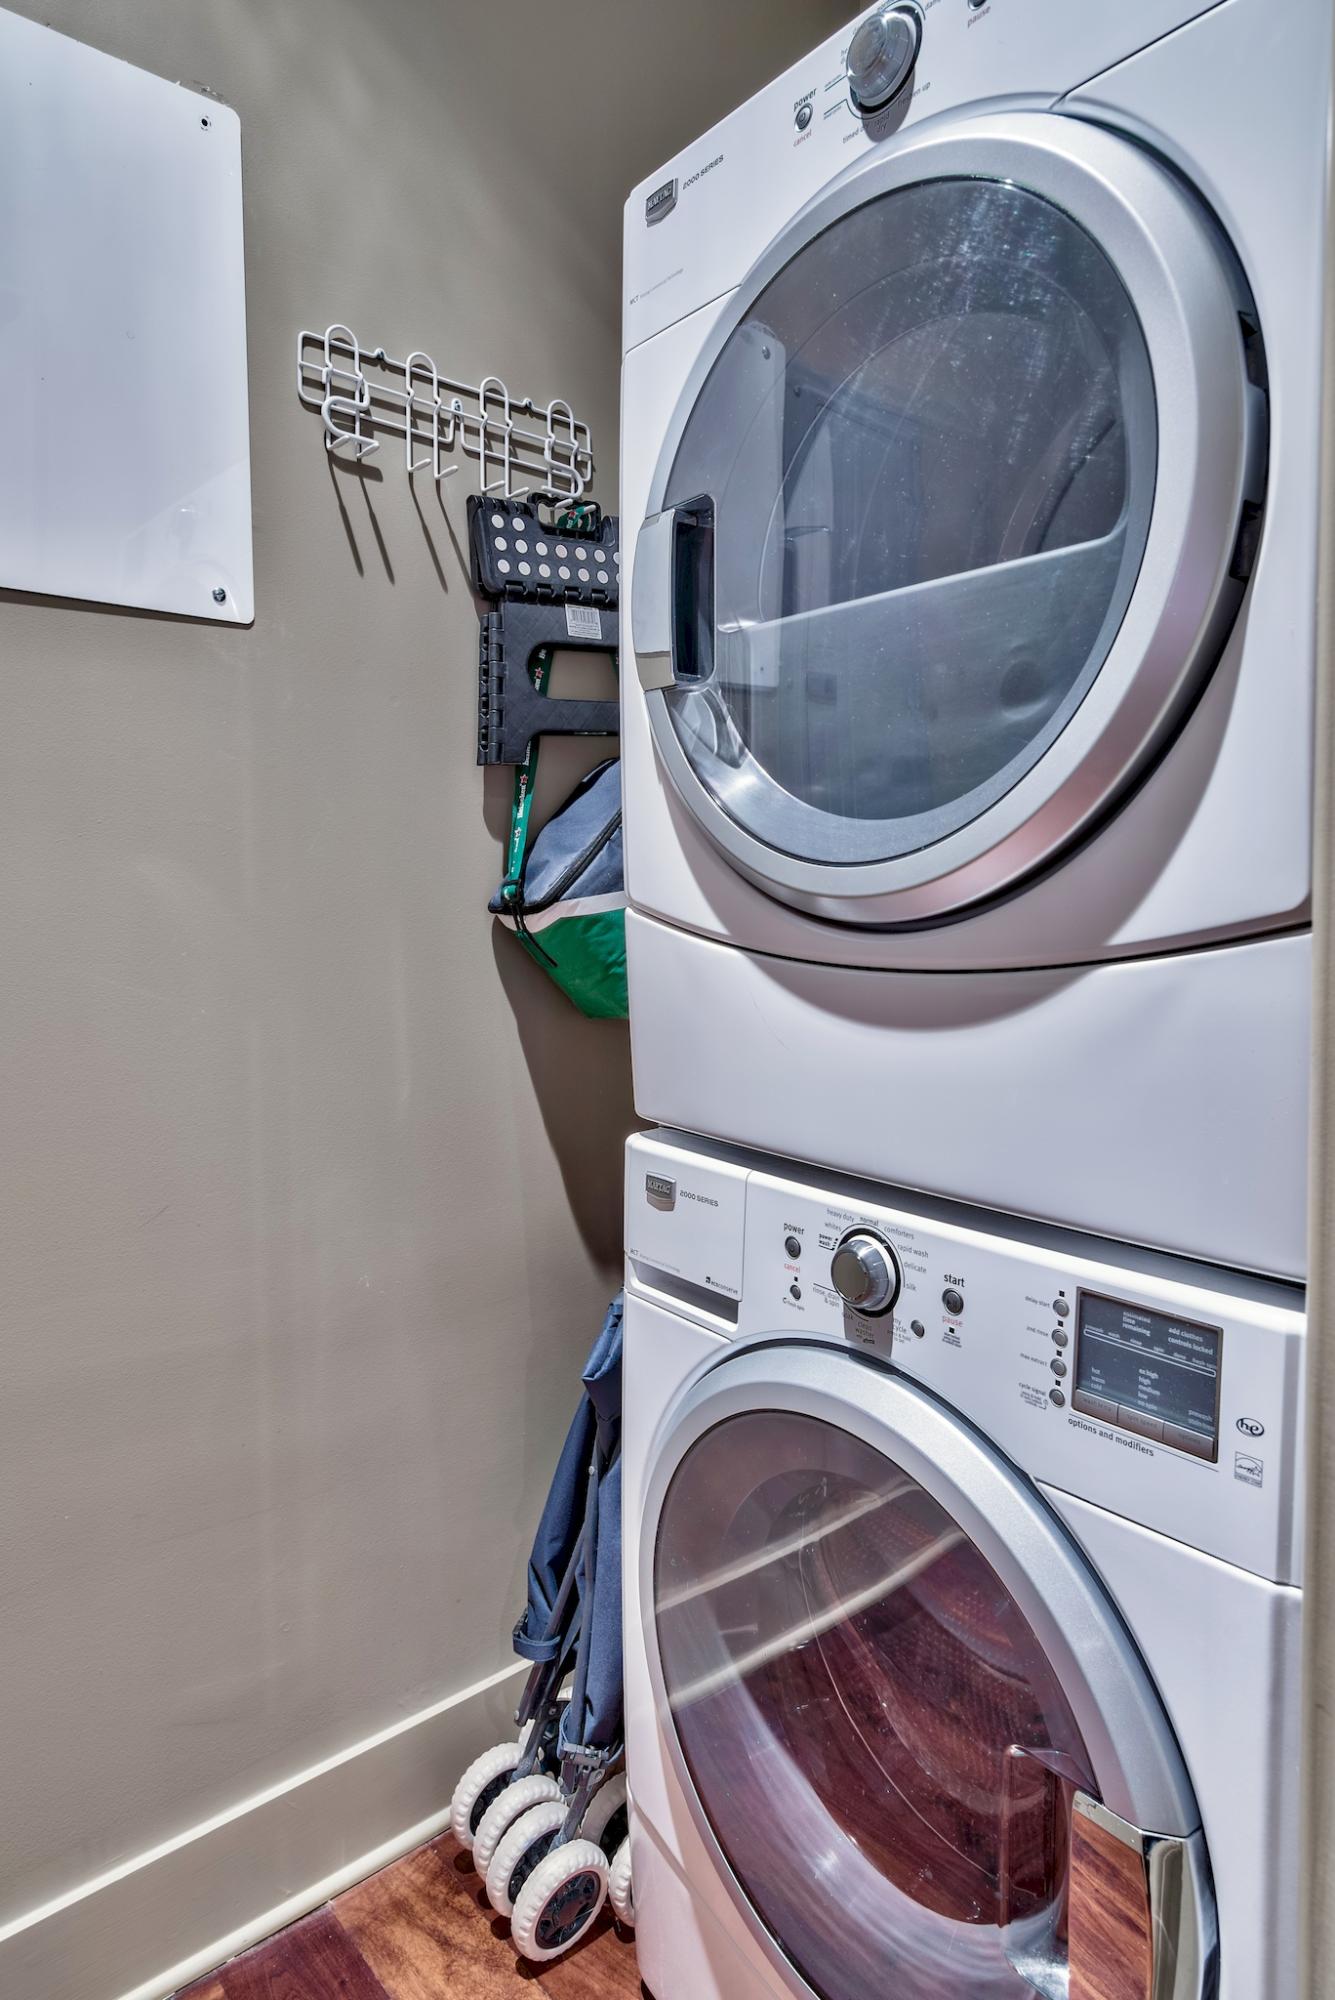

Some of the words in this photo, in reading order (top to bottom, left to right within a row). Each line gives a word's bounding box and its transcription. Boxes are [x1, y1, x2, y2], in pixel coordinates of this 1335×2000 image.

[967, 6, 991, 28] pause
[793, 88, 818, 112] power
[793, 129, 812, 147] cancel
[683, 173, 700, 190] 2000
[700, 155, 724, 176] SERIES
[680, 1190, 696, 1200] 2000
[696, 1195, 719, 1207] SERIES
[826, 1208, 842, 1220] heavy
[843, 1213, 855, 1222] duty
[784, 1223, 805, 1235] power
[884, 1225, 915, 1239] comforters
[897, 1243, 912, 1254] rapid
[913, 1249, 929, 1258] wash
[784, 1263, 801, 1273] cancel
[904, 1261, 927, 1273] delicate
[906, 1282, 917, 1291] silk
[943, 1273, 965, 1288] start
[942, 1316, 964, 1327] pause
[1122, 1323, 1151, 1337] remaining
[1168, 1327, 1180, 1335] add
[1181, 1330, 1203, 1342] clothes
[1168, 1337, 1192, 1349] controls
[1192, 1344, 1213, 1355] locked
[1068, 1418, 1097, 1434] options
[1098, 1428, 1113, 1441] and
[1115, 1436, 1155, 1457] modifiers
